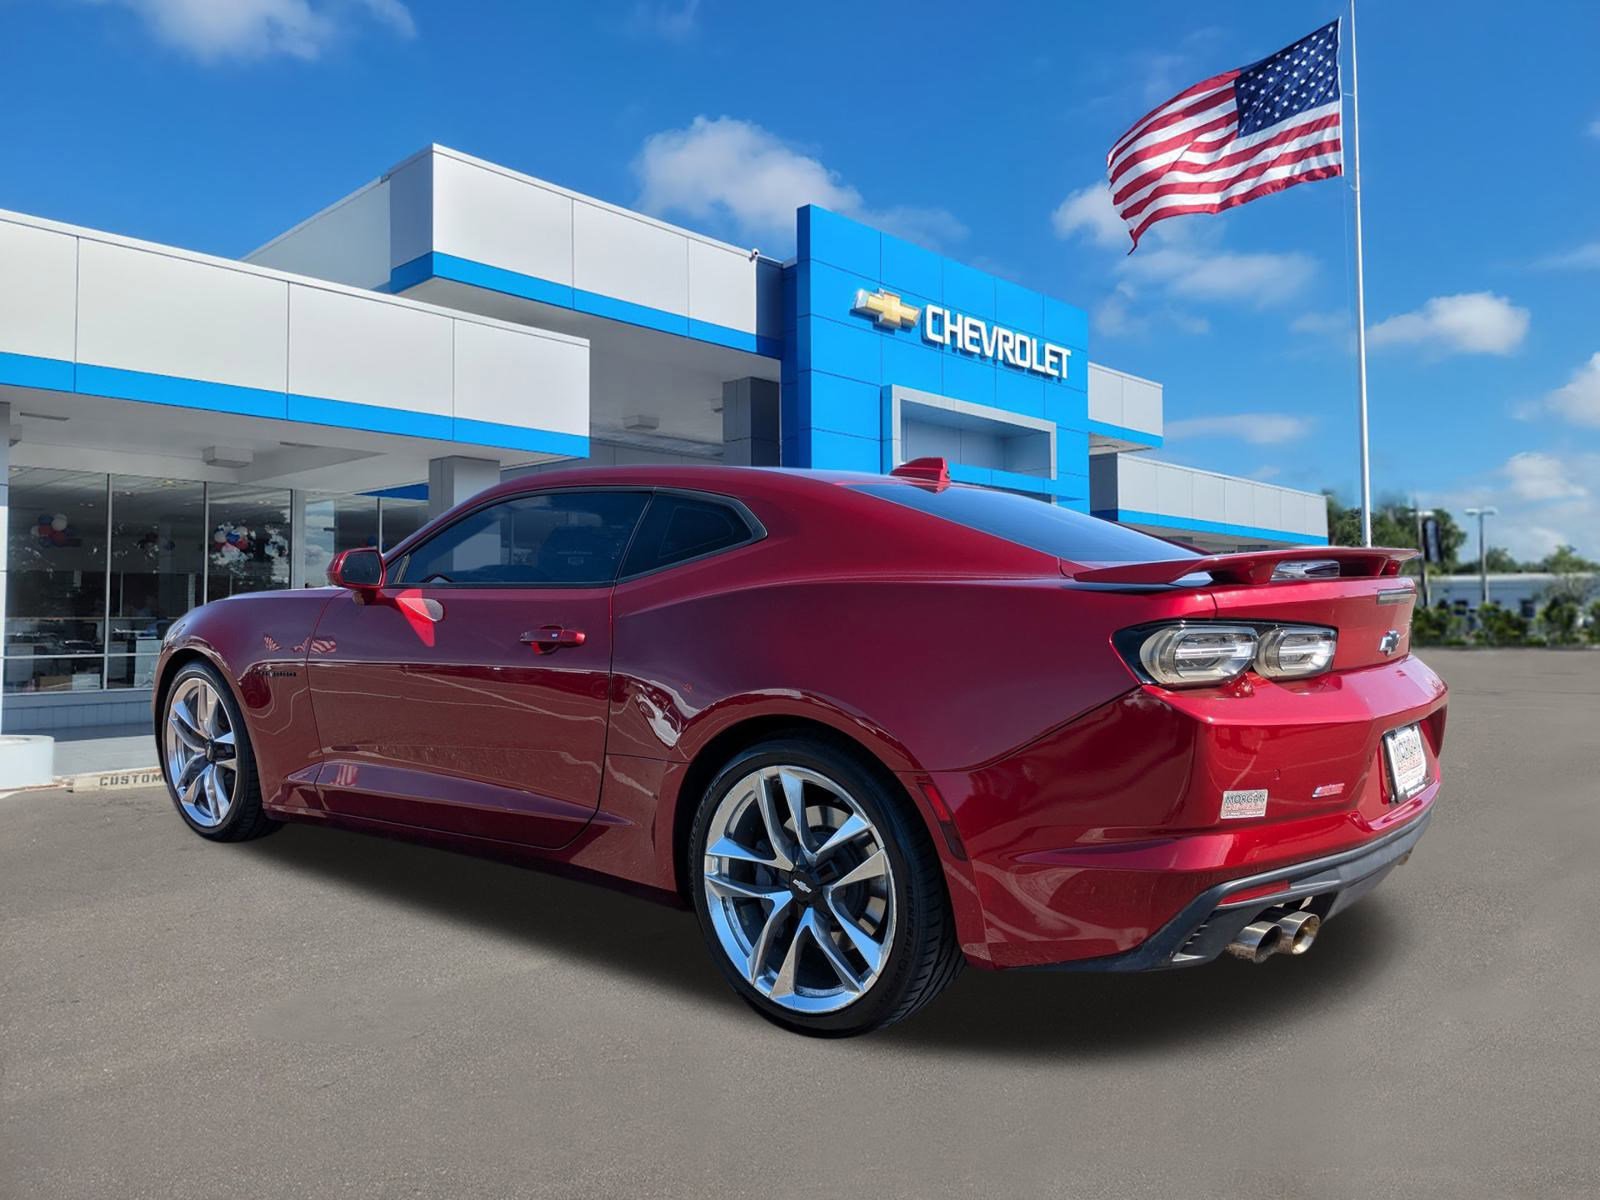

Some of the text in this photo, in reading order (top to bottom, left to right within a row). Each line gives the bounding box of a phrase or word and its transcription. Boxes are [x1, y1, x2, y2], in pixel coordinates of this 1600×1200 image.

[925, 304, 1072, 379] CHEVROLET
[100, 774, 162, 786] CUSTOM
[1225, 792, 1266, 804] MORGAN
